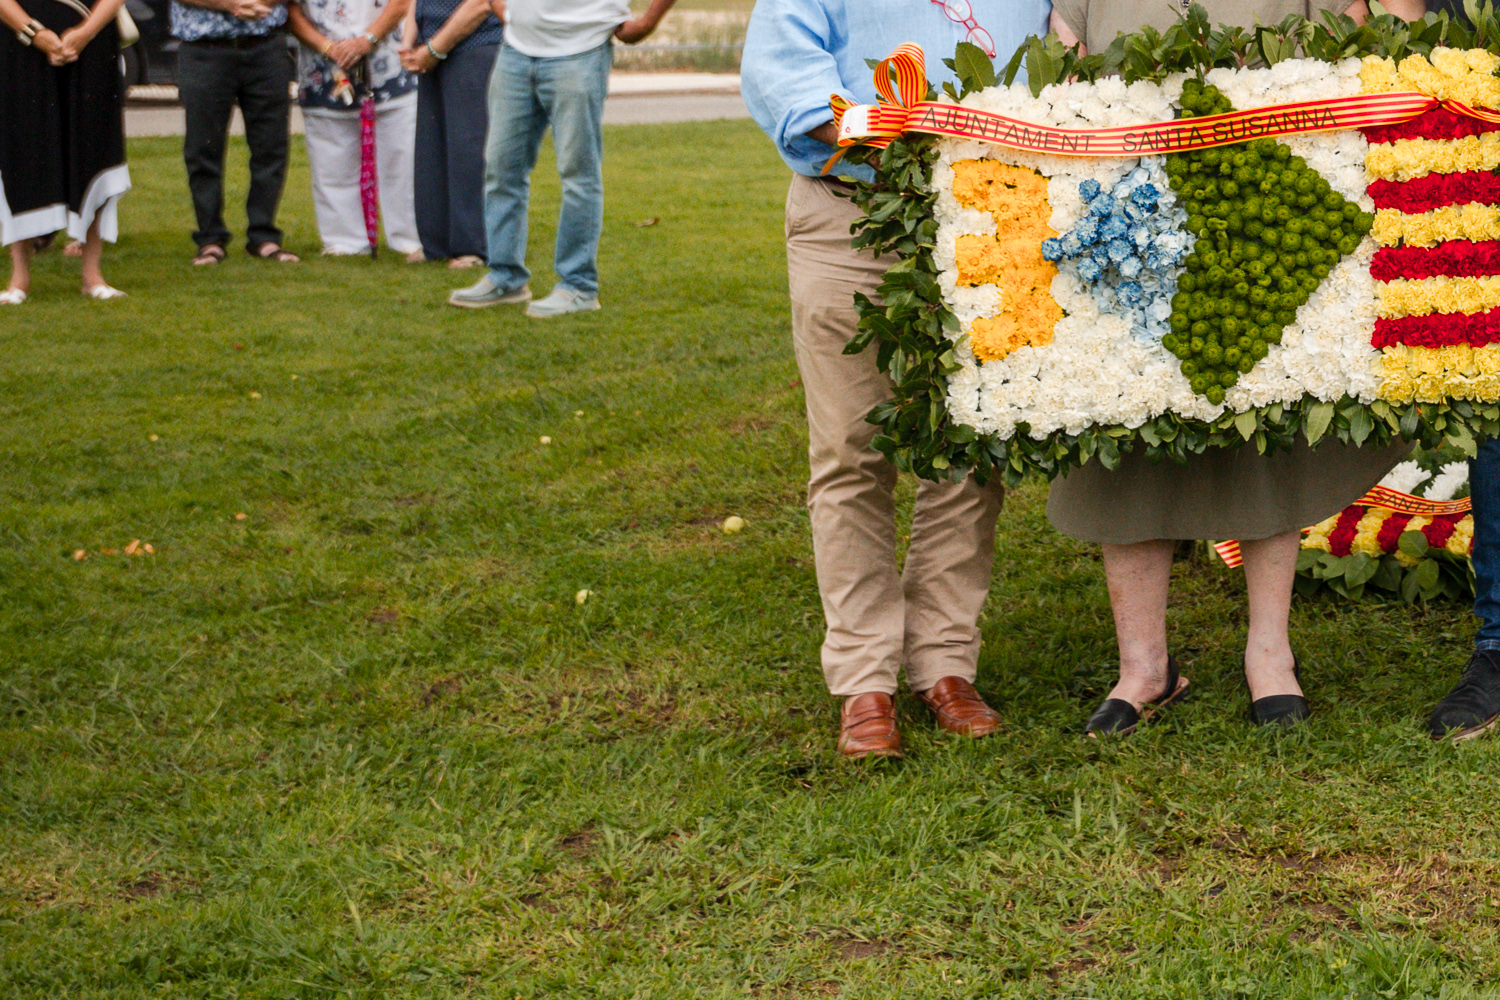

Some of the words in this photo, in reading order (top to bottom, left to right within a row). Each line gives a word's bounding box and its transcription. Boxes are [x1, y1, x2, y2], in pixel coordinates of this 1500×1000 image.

[920, 107, 1096, 151] AJUNTAMENT
[1122, 126, 1206, 152] SANTA
[1212, 107, 1338, 142] SUSANNA
[1373, 489, 1435, 512] SANTA
